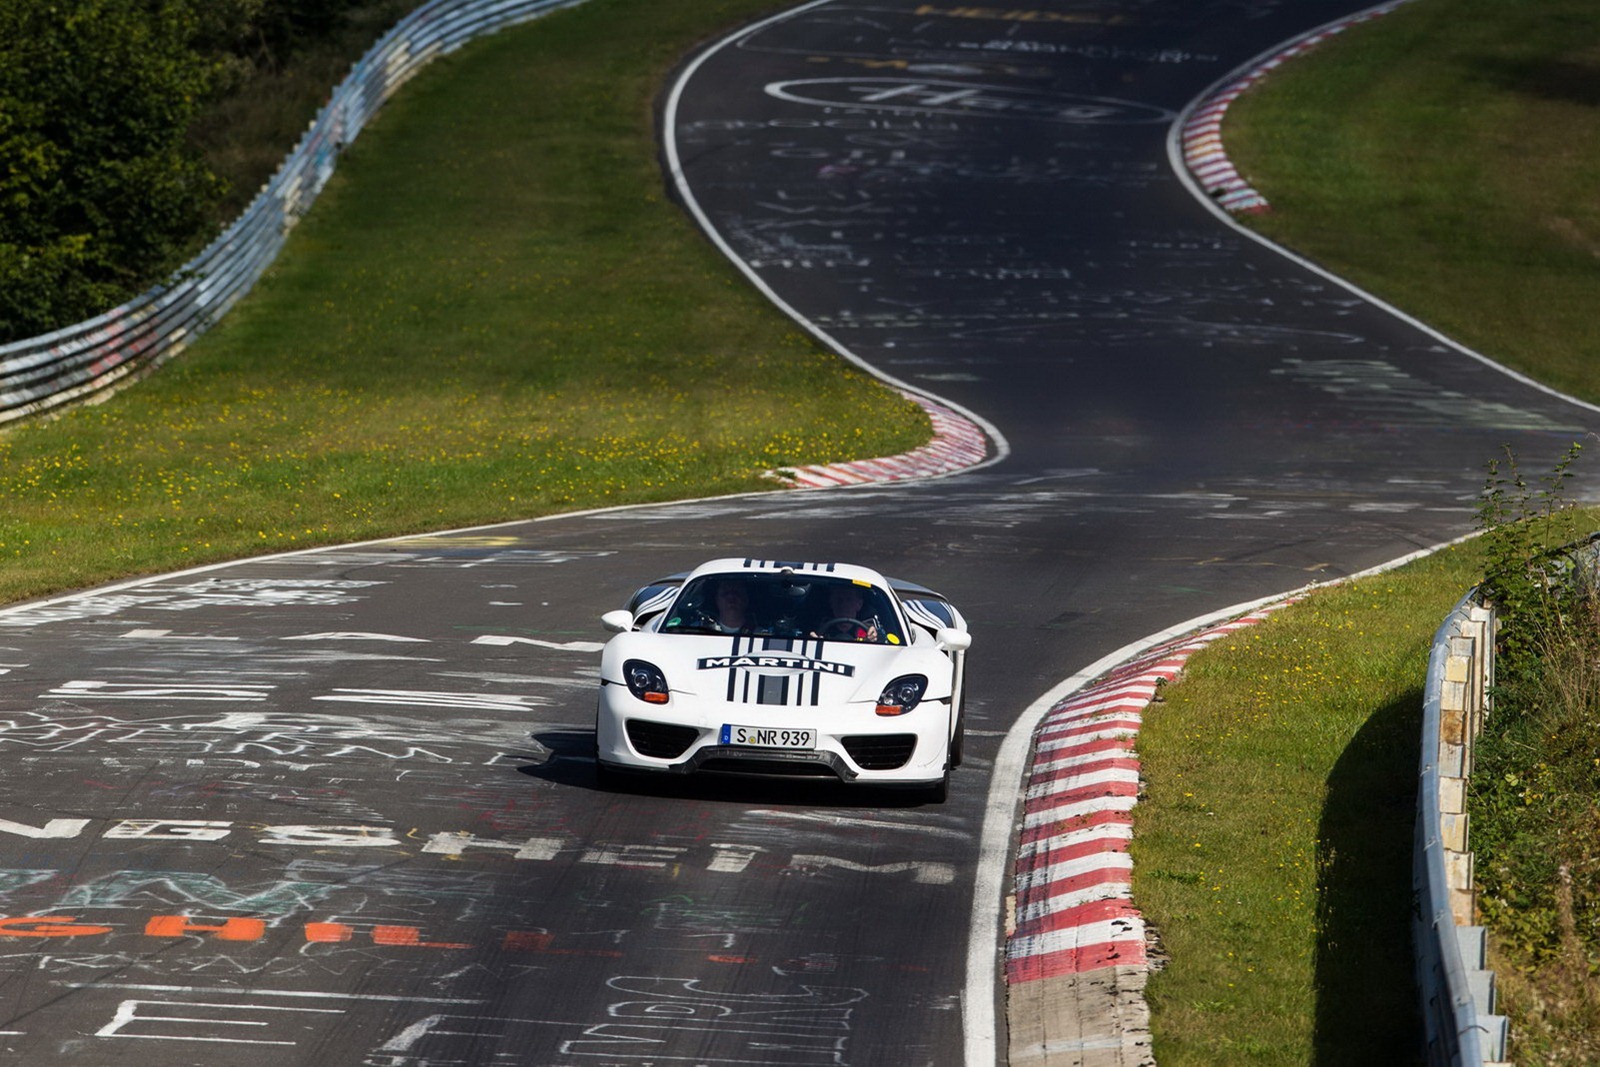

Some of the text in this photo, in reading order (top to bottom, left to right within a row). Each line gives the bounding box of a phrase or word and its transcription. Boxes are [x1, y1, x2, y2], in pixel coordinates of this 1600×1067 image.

[705, 657, 845, 674] MARTINI
[737, 728, 810, 746] S NR 939
